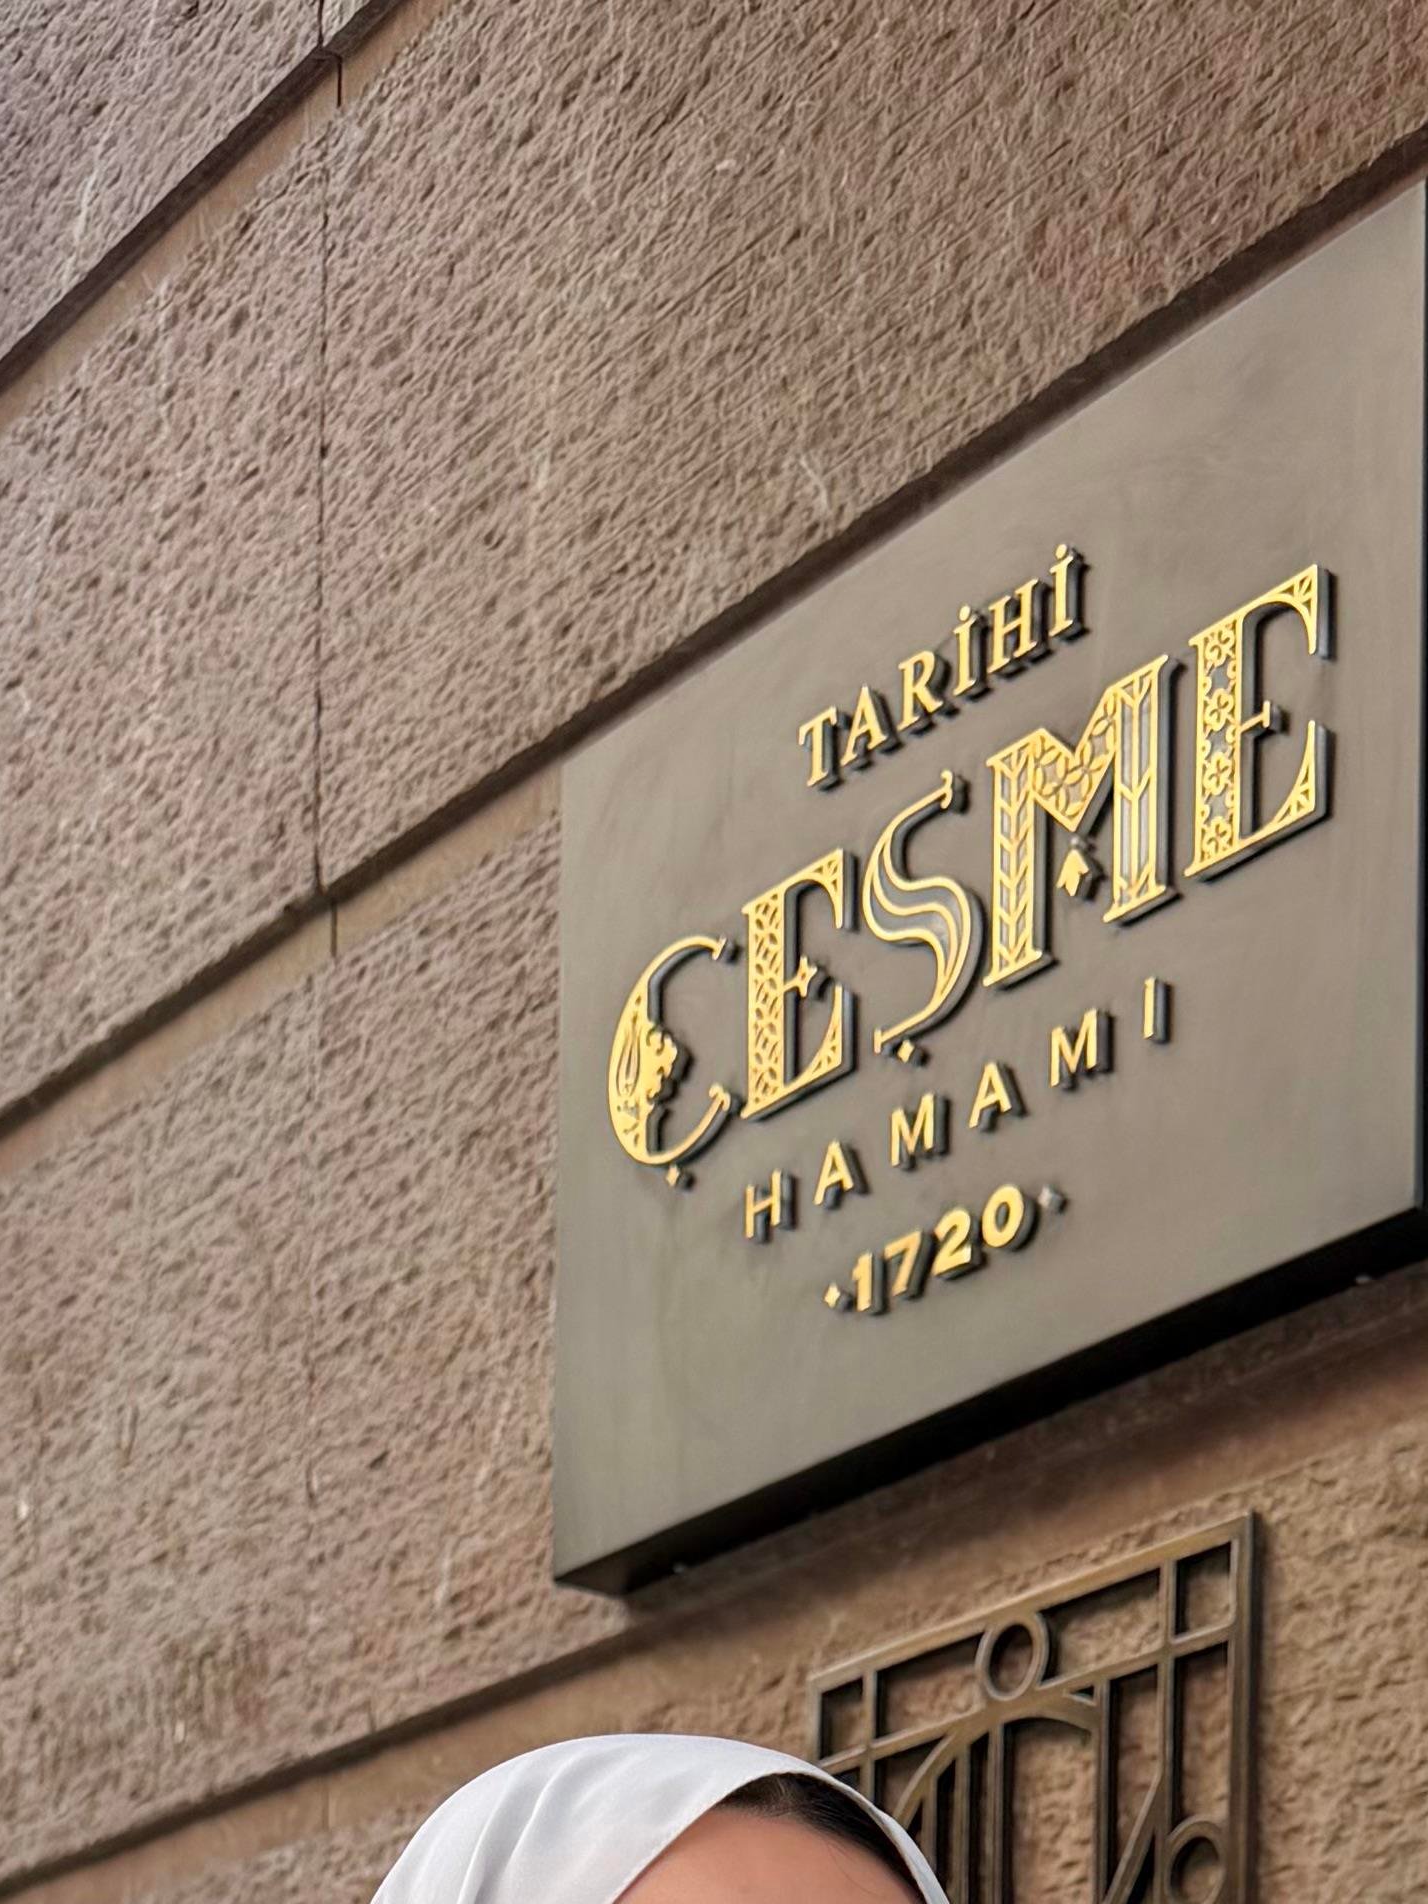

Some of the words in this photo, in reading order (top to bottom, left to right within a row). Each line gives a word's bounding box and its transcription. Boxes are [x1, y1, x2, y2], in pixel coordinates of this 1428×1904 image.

[798, 543, 1084, 788] TARİHİ
[608, 563, 1328, 1187] ÇEŞME
[744, 977, 1169, 1240] HAMAMI
